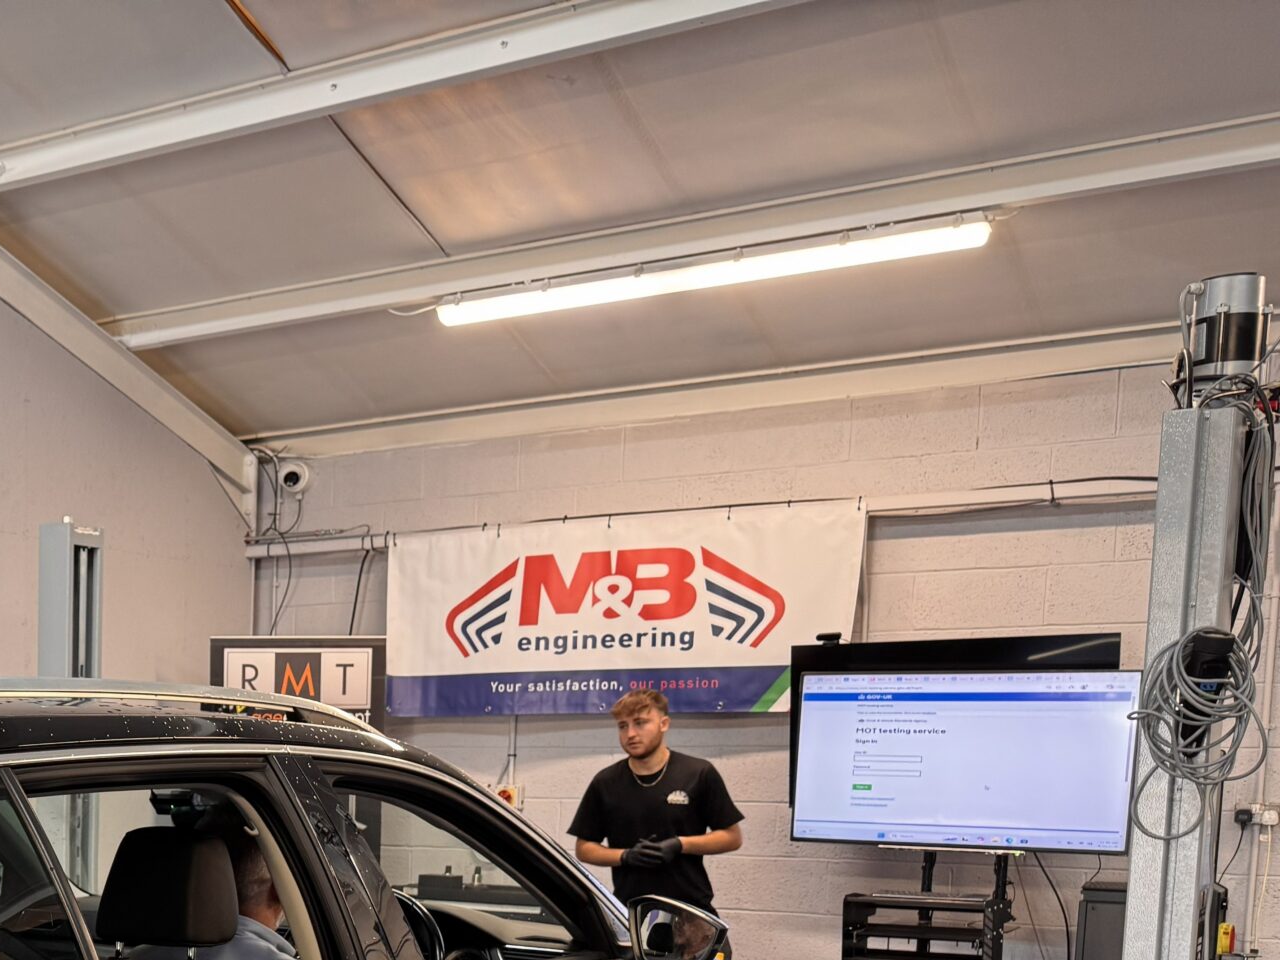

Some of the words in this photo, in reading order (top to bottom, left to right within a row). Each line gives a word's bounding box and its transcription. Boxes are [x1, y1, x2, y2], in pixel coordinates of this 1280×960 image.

[519, 547, 697, 626] M&B
[517, 628, 695, 655] engineering
[490, 681, 520, 693] Your
[527, 678, 624, 692] satisfaction,
[629, 679, 655, 690] our
[660, 676, 719, 691] passion
[856, 727, 877, 735] MOT
[879, 727, 911, 736] testing
